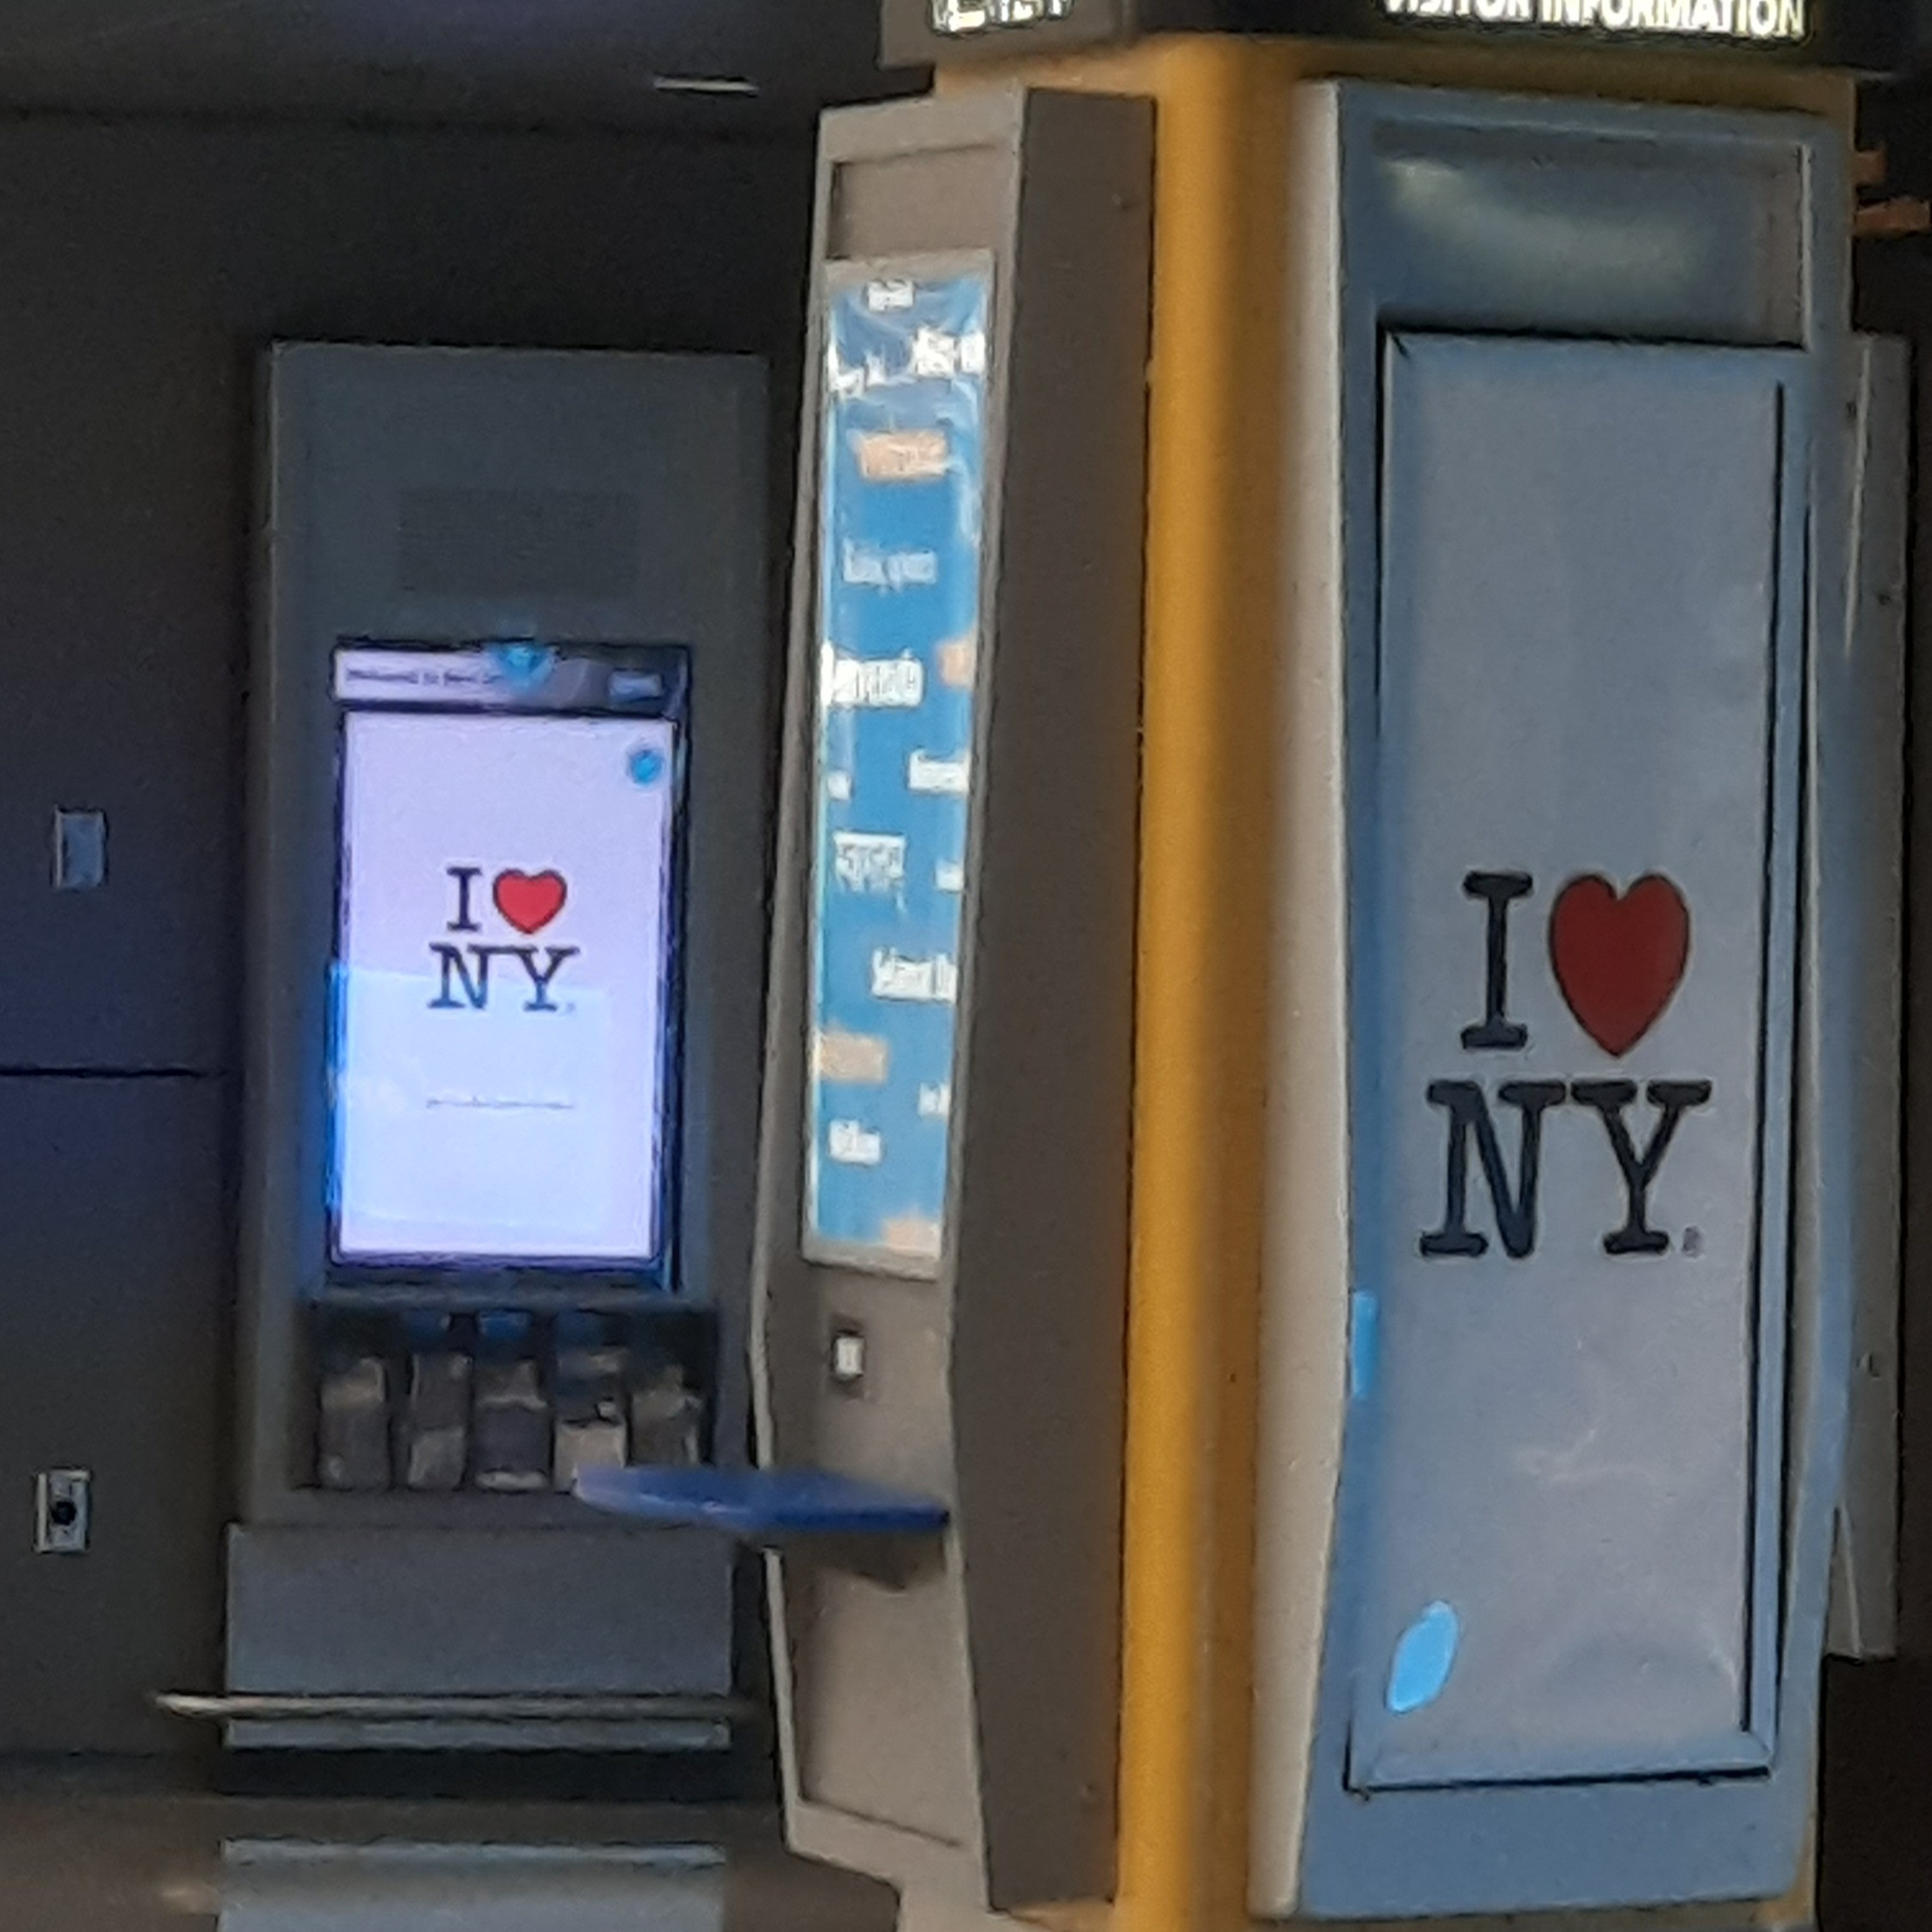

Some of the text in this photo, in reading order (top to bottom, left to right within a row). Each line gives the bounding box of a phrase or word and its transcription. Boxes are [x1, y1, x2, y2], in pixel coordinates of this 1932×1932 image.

[446, 866, 483, 932] I
[1461, 871, 1533, 1050] I
[427, 942, 580, 1012] NY
[1419, 1079, 1712, 1258] NY
